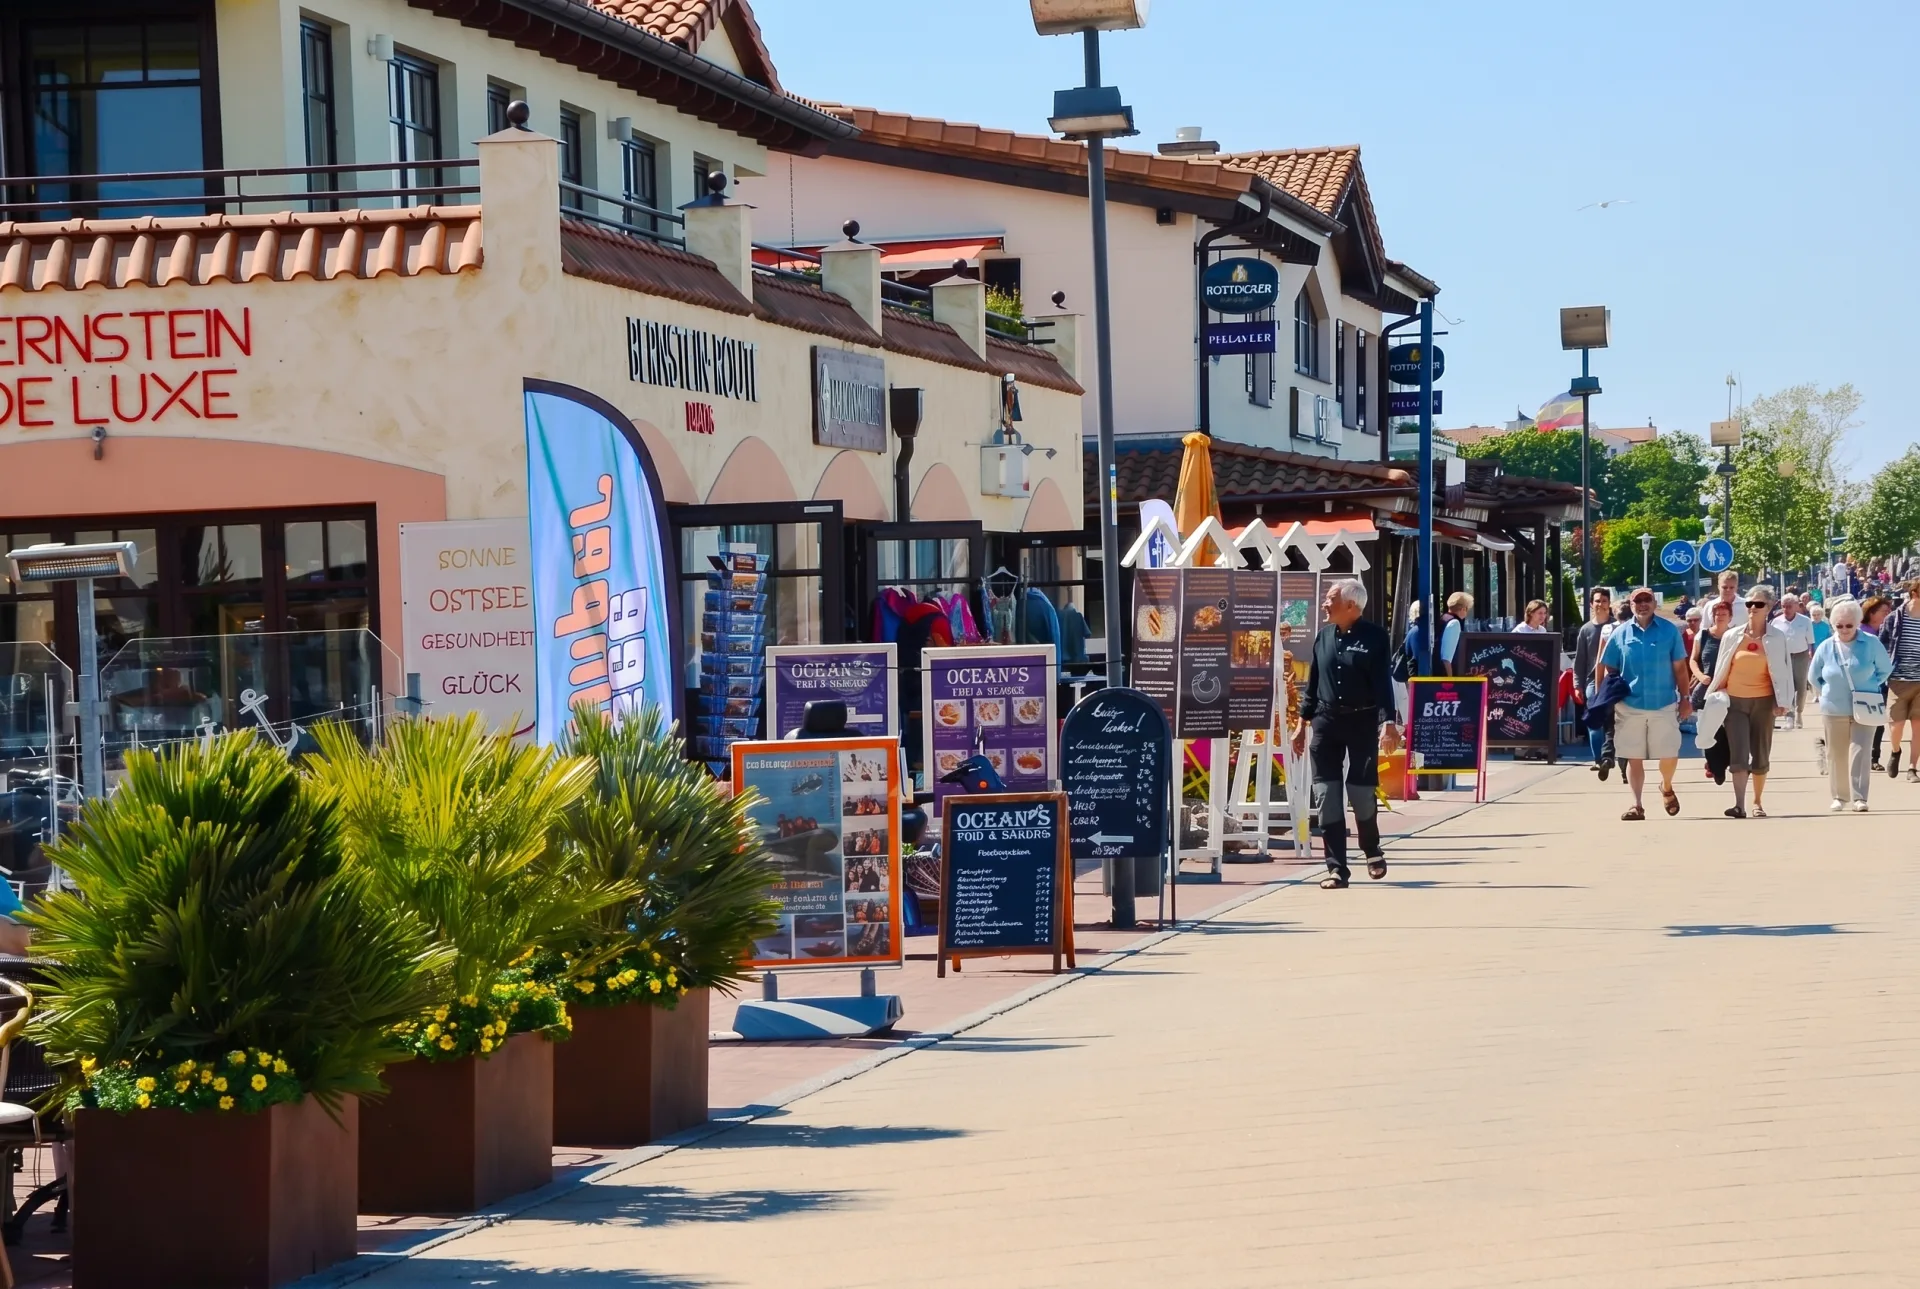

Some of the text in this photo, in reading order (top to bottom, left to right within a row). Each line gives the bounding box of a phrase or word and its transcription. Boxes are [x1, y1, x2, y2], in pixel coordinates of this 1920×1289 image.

[72, 369, 238, 424] LUXE
[438, 547, 516, 570] SONNE
[429, 586, 528, 613] OSTSEE
[422, 631, 535, 650] GESUNDHEIT
[442, 671, 522, 695] GLÜCK
[947, 666, 1030, 685] OCEAN'S
[957, 804, 1051, 829] OCEAN'S
